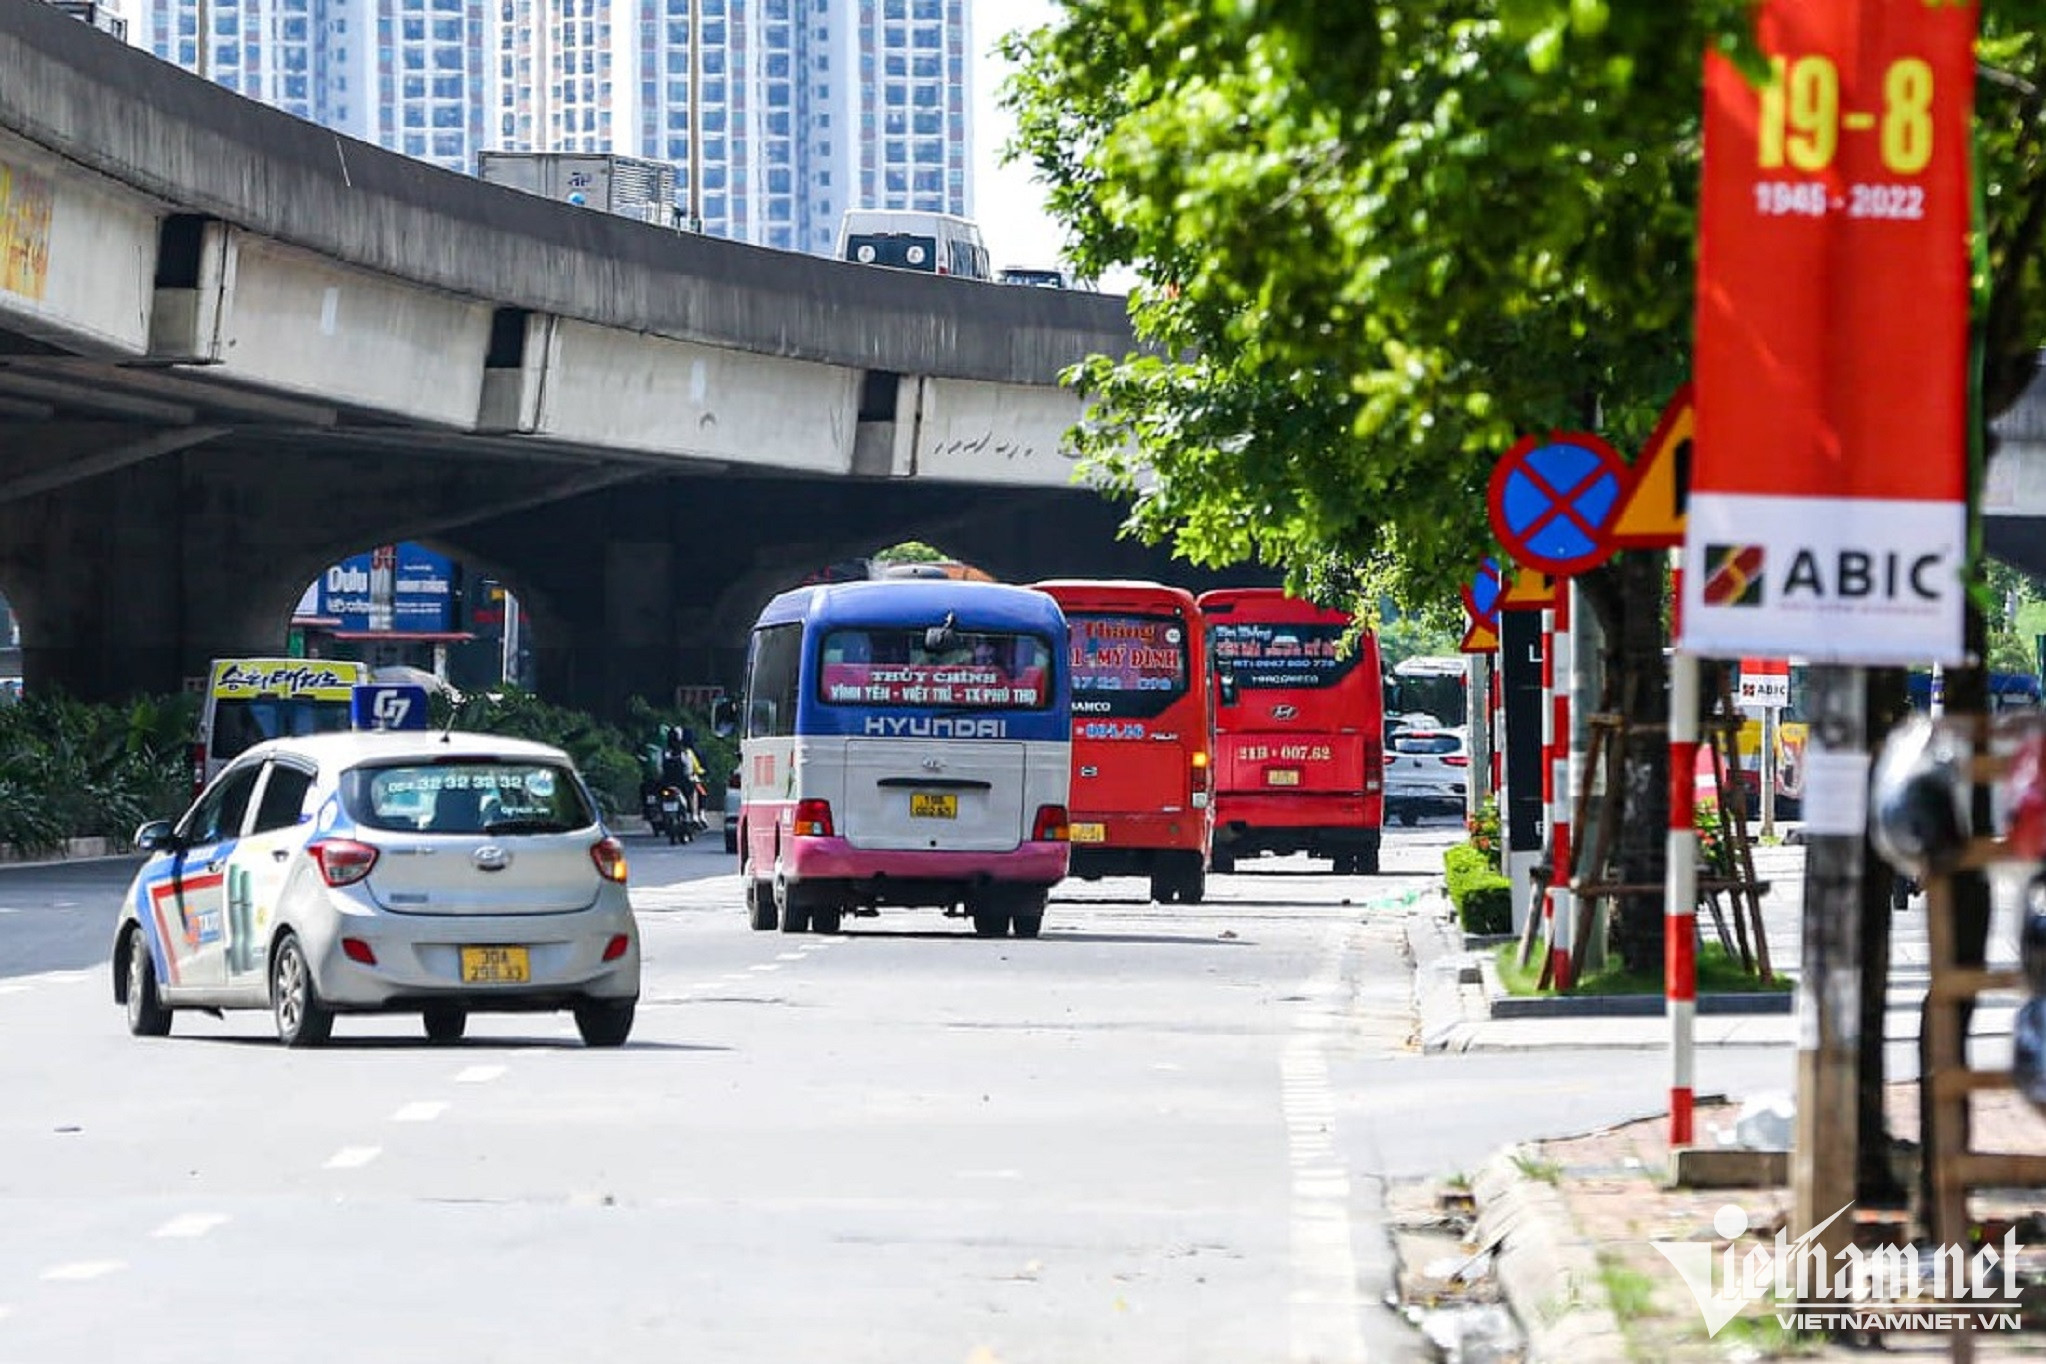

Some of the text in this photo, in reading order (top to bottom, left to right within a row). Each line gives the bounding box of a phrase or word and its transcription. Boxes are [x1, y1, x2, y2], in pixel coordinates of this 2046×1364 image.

[1850, 183, 1925, 219] 2022
[1782, 550, 1943, 600] ABIC
[372, 689, 411, 727] G7
[864, 717, 1006, 738] HYUNDAI
